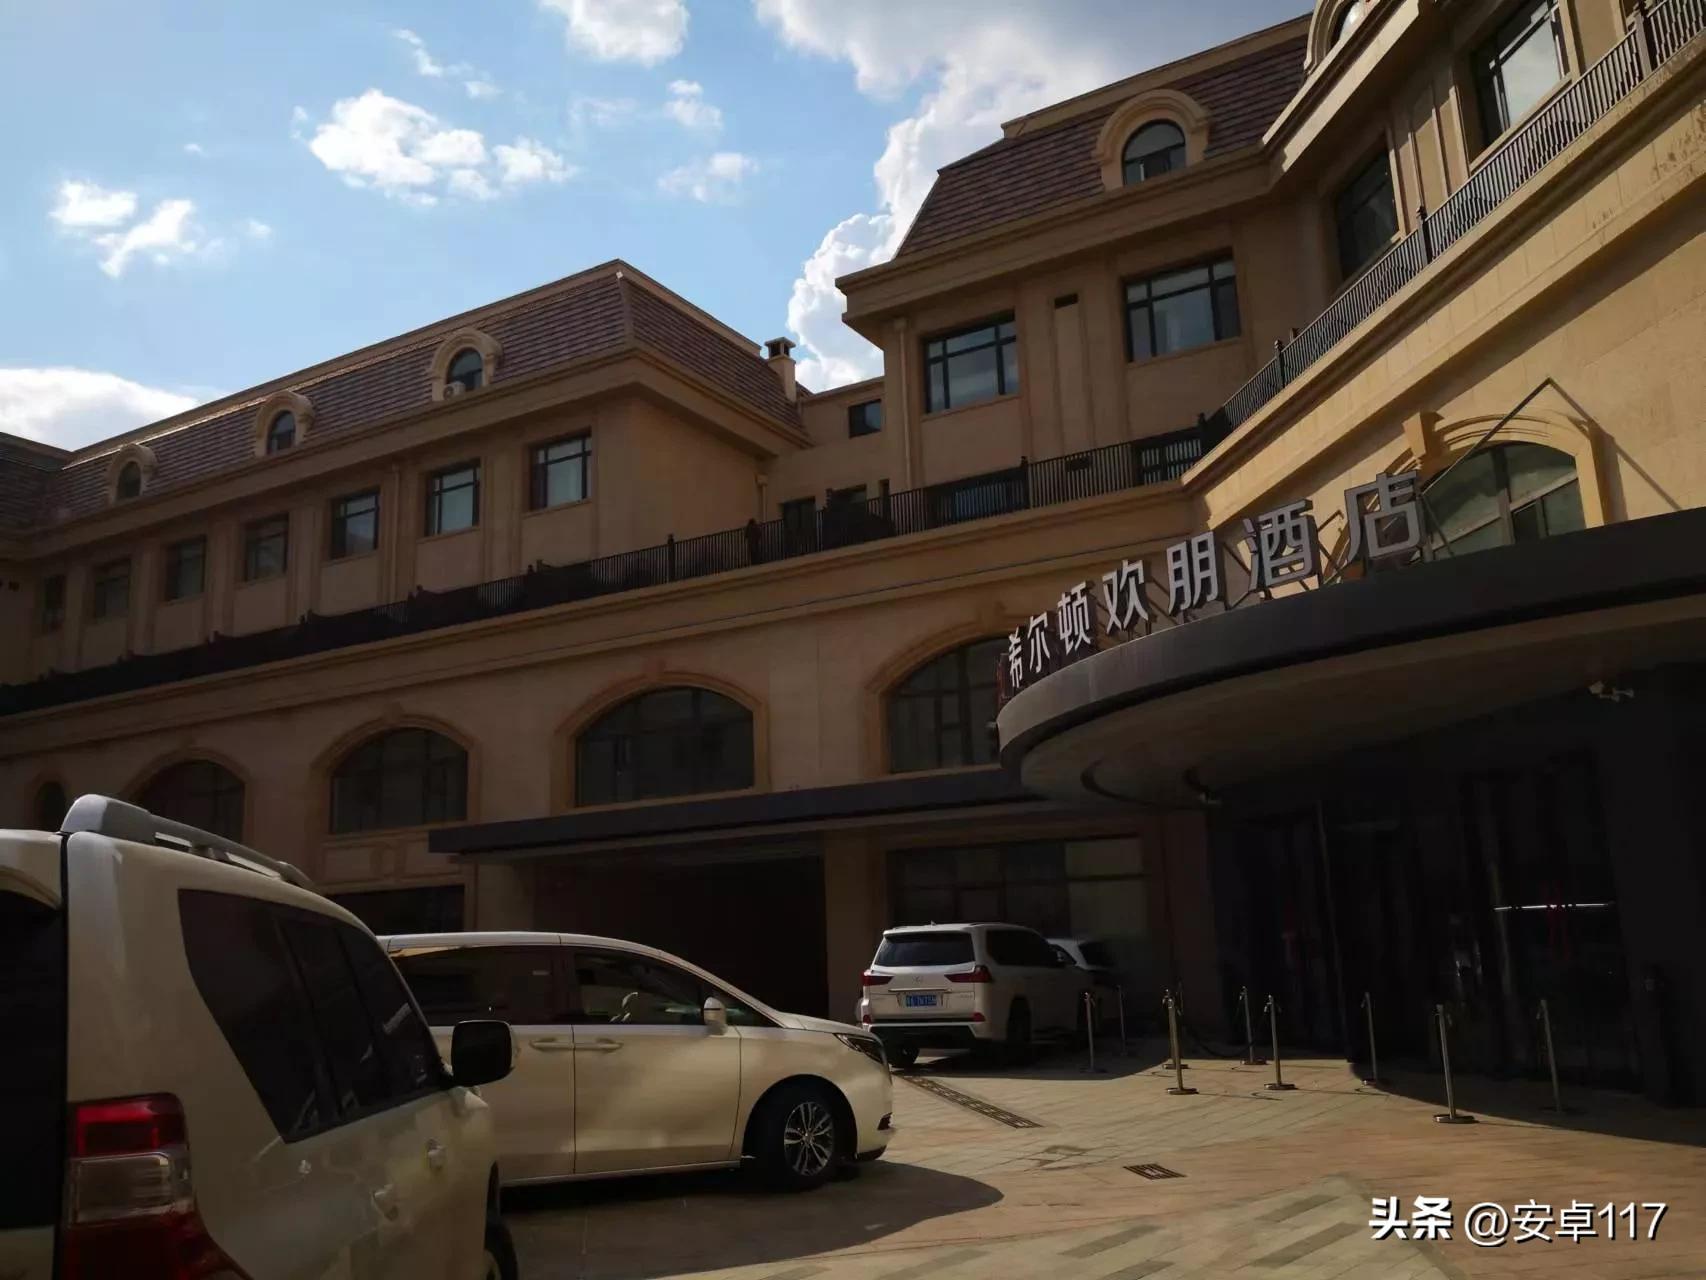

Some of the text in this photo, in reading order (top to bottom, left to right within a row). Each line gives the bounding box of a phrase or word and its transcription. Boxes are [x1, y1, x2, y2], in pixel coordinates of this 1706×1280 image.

[1007, 471, 1425, 689] 希尔顿欢朋酒店
